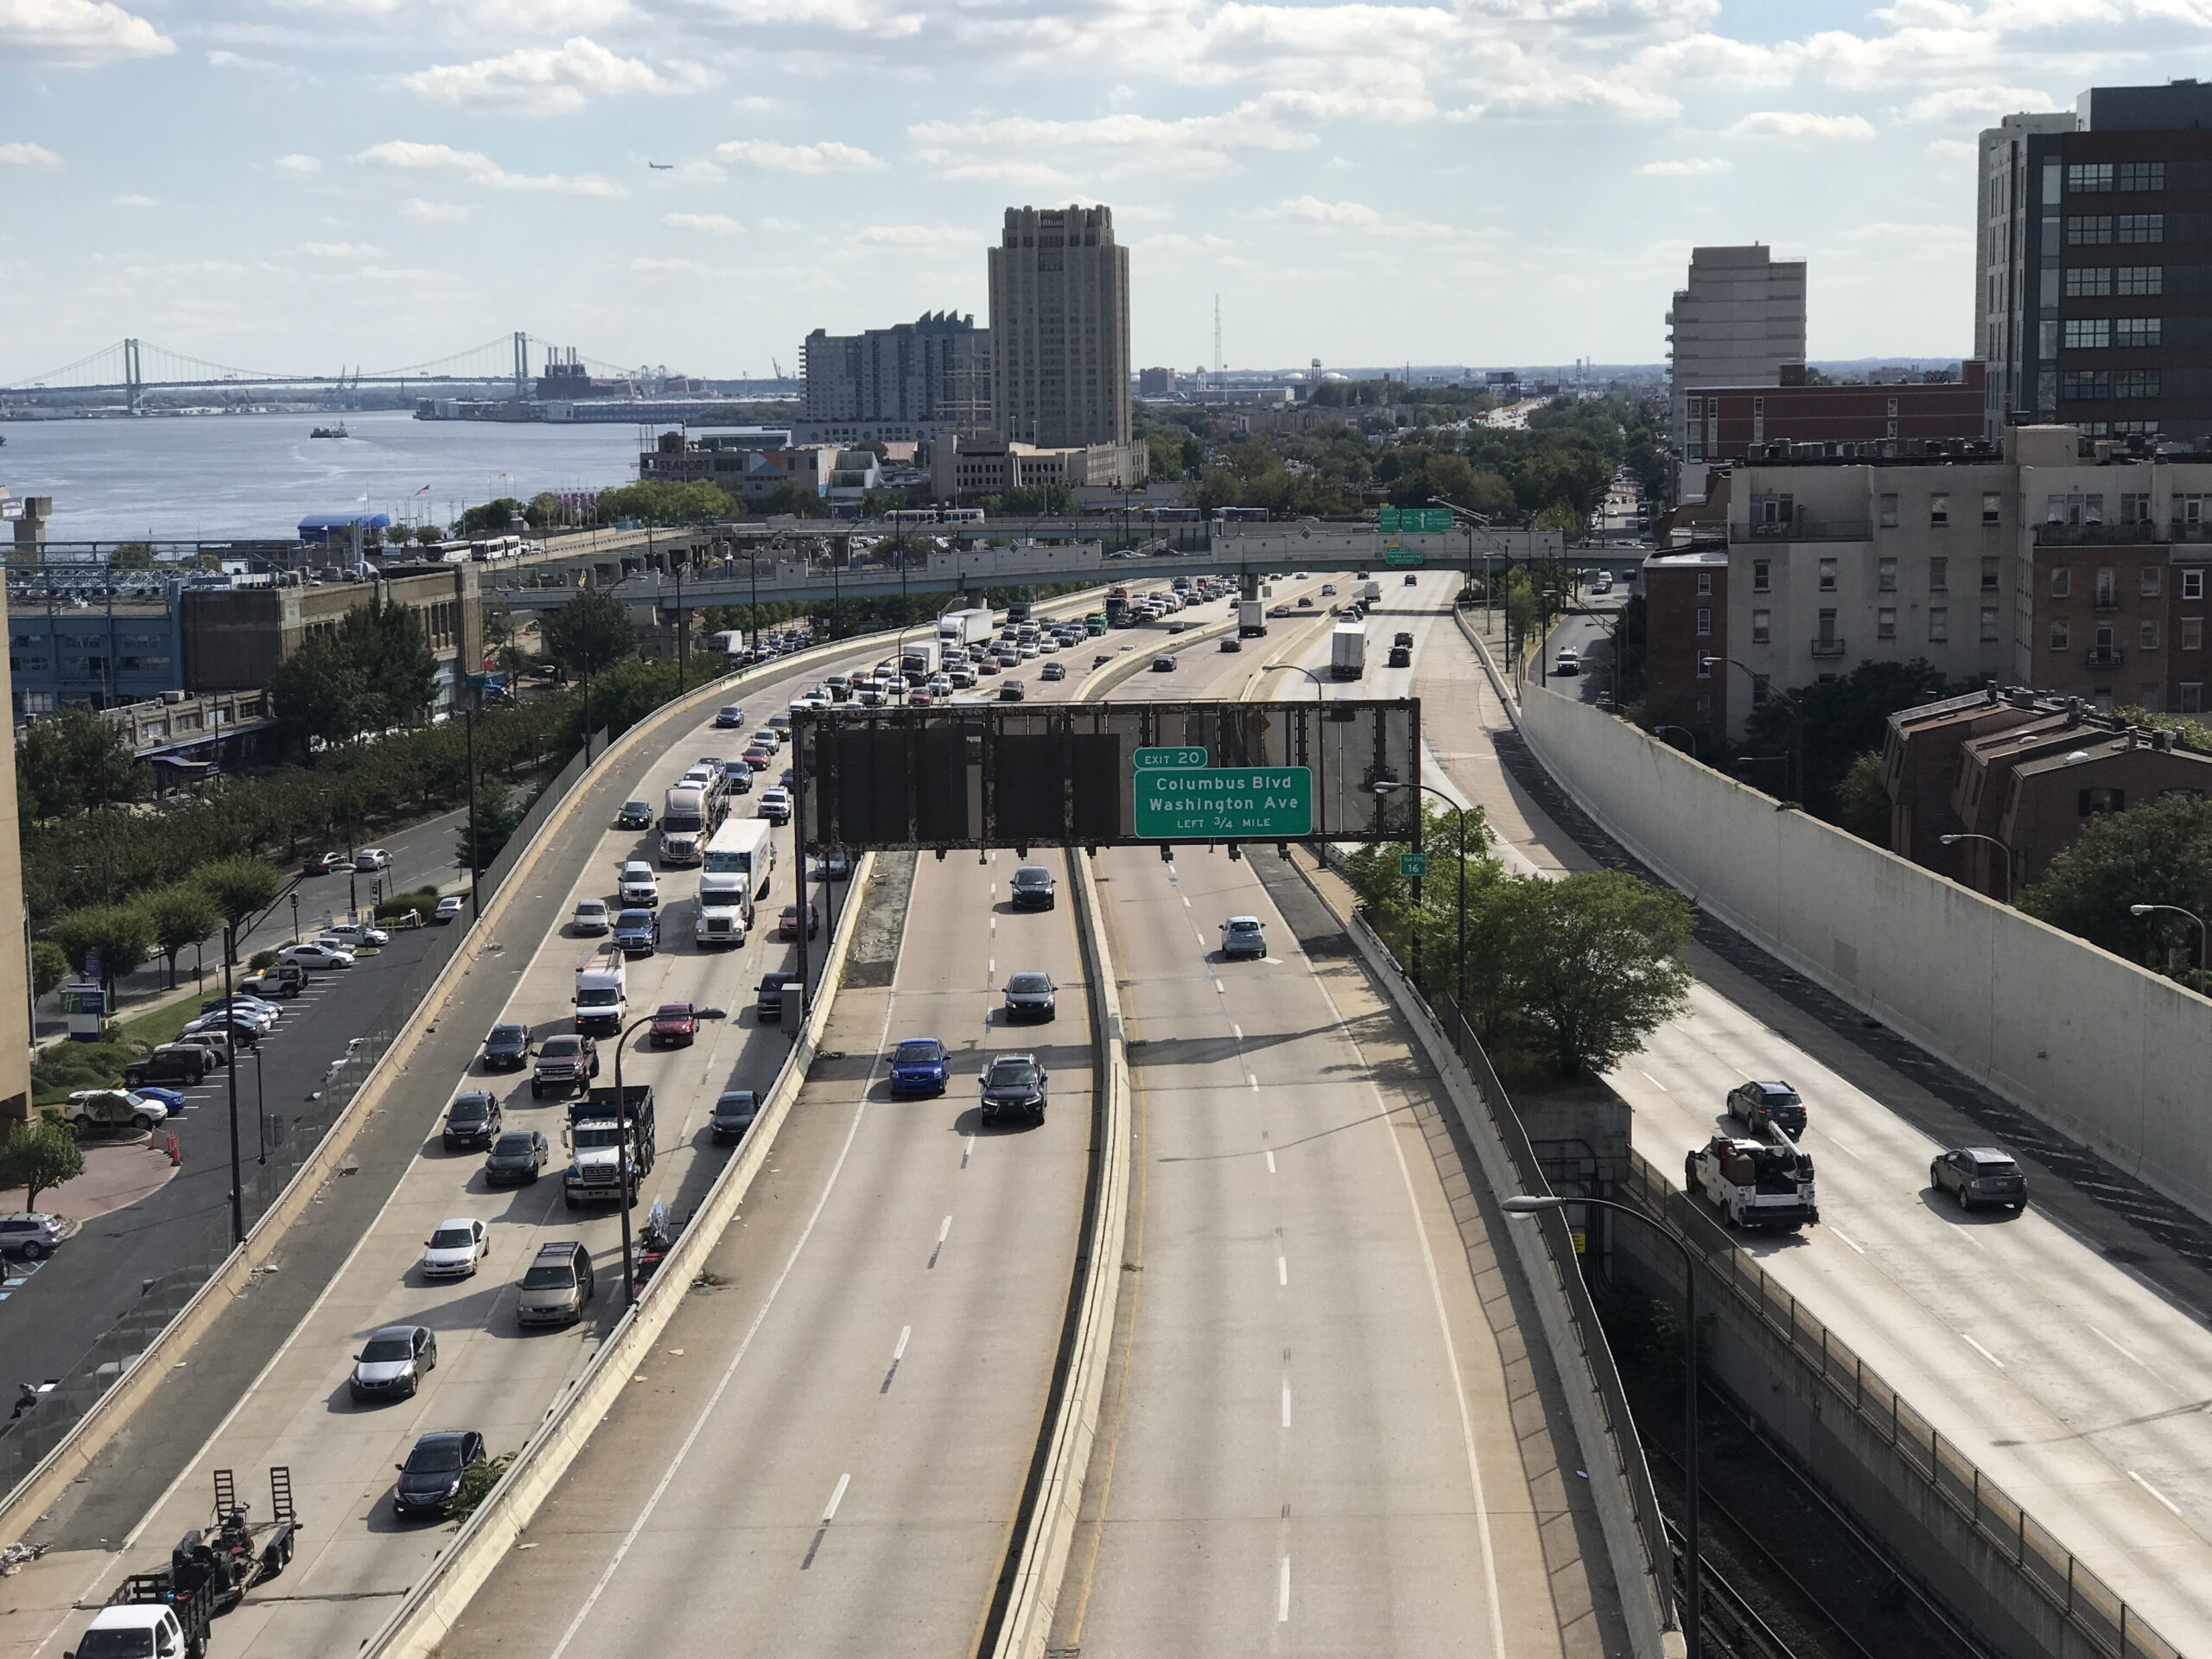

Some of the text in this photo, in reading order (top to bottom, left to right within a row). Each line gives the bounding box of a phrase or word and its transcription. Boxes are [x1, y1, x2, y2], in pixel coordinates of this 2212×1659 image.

[659, 460, 710, 471] SEAPORT
[1145, 752, 1199, 765] EXIT 20
[1156, 776, 1291, 791] Columbus Blvd
[1150, 797, 1299, 813] Washington Ave
[1178, 817, 1270, 830] LEFT 3/4 MILE
[1408, 864, 1419, 873] 16
